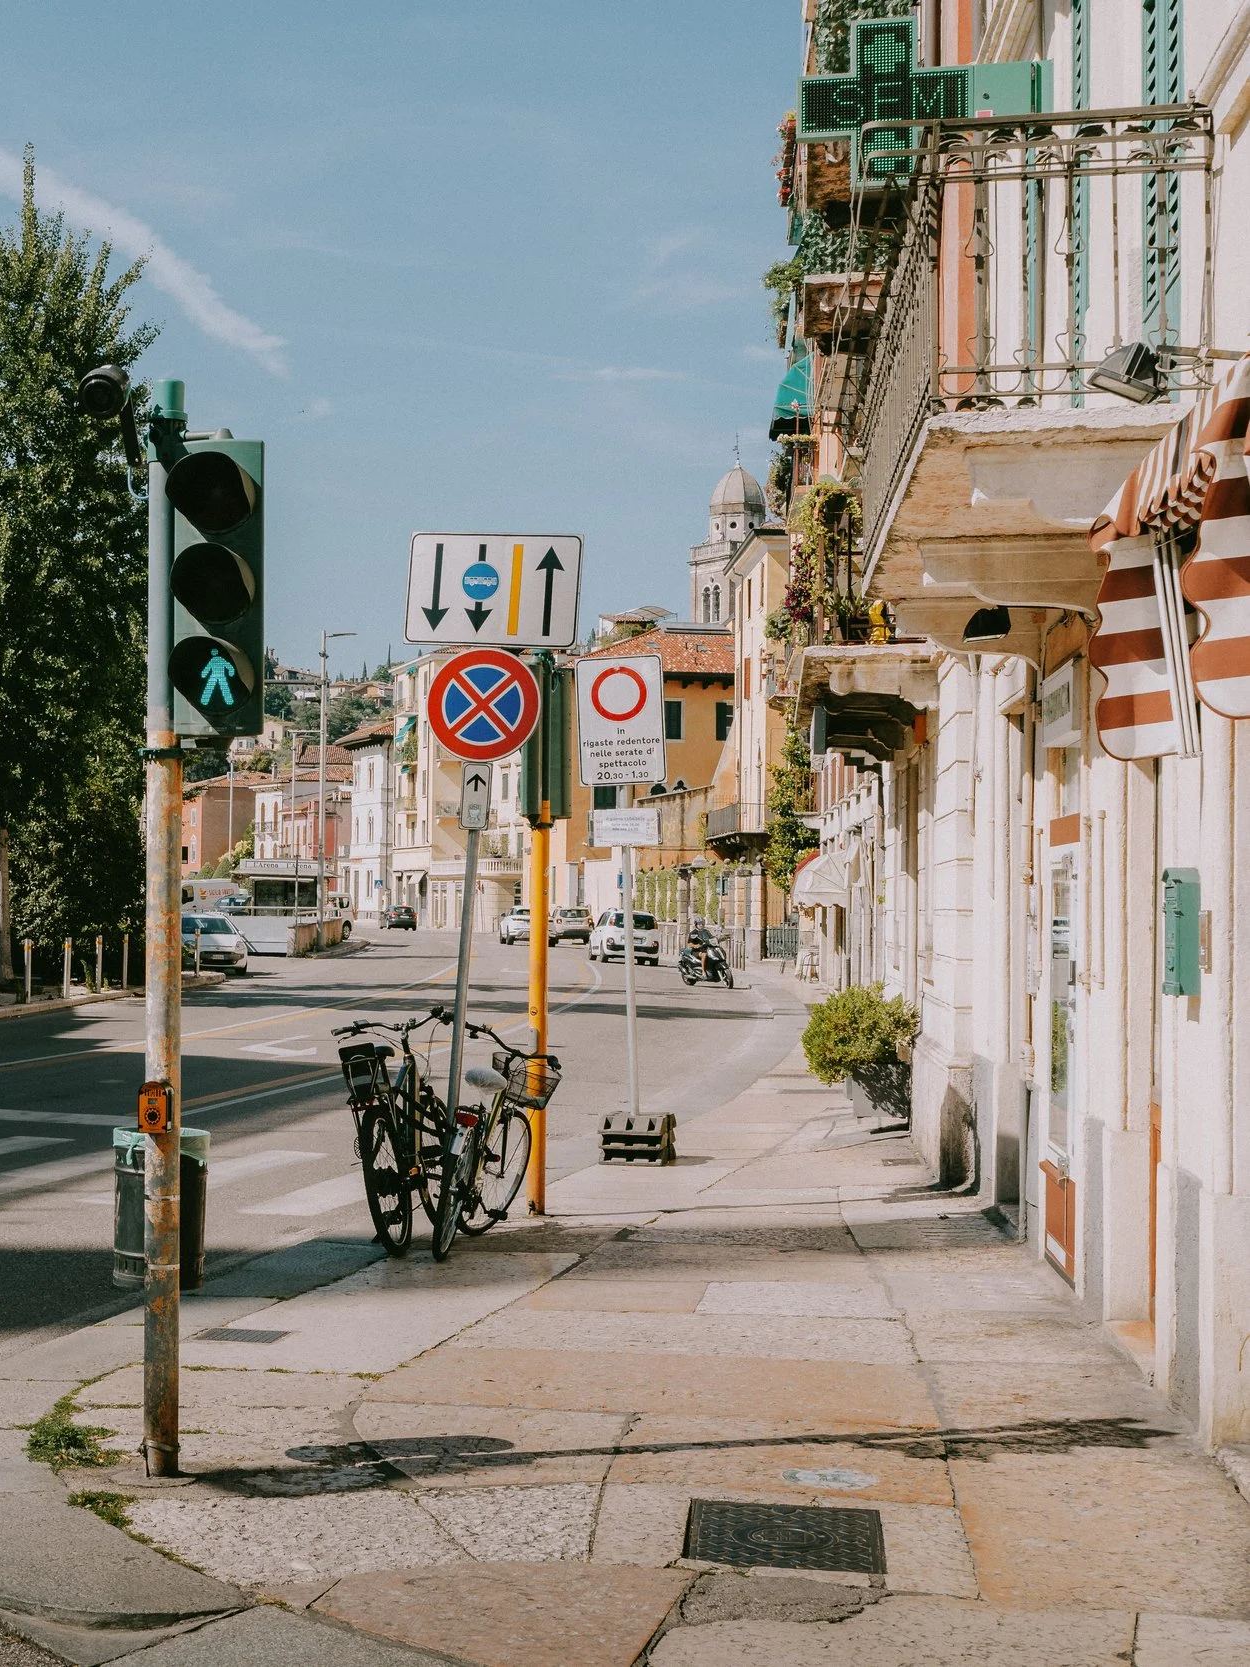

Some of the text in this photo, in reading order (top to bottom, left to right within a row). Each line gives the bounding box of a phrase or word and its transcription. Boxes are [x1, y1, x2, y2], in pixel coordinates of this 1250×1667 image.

[617, 727, 626, 735] in
[583, 736, 661, 748] rigaste redentore
[590, 749, 612, 758] nelle
[615, 748, 644, 757] serate
[599, 758, 647, 769] spettacolo
[596, 771, 624, 780] 20.30
[631, 770, 649, 779] 1.30
